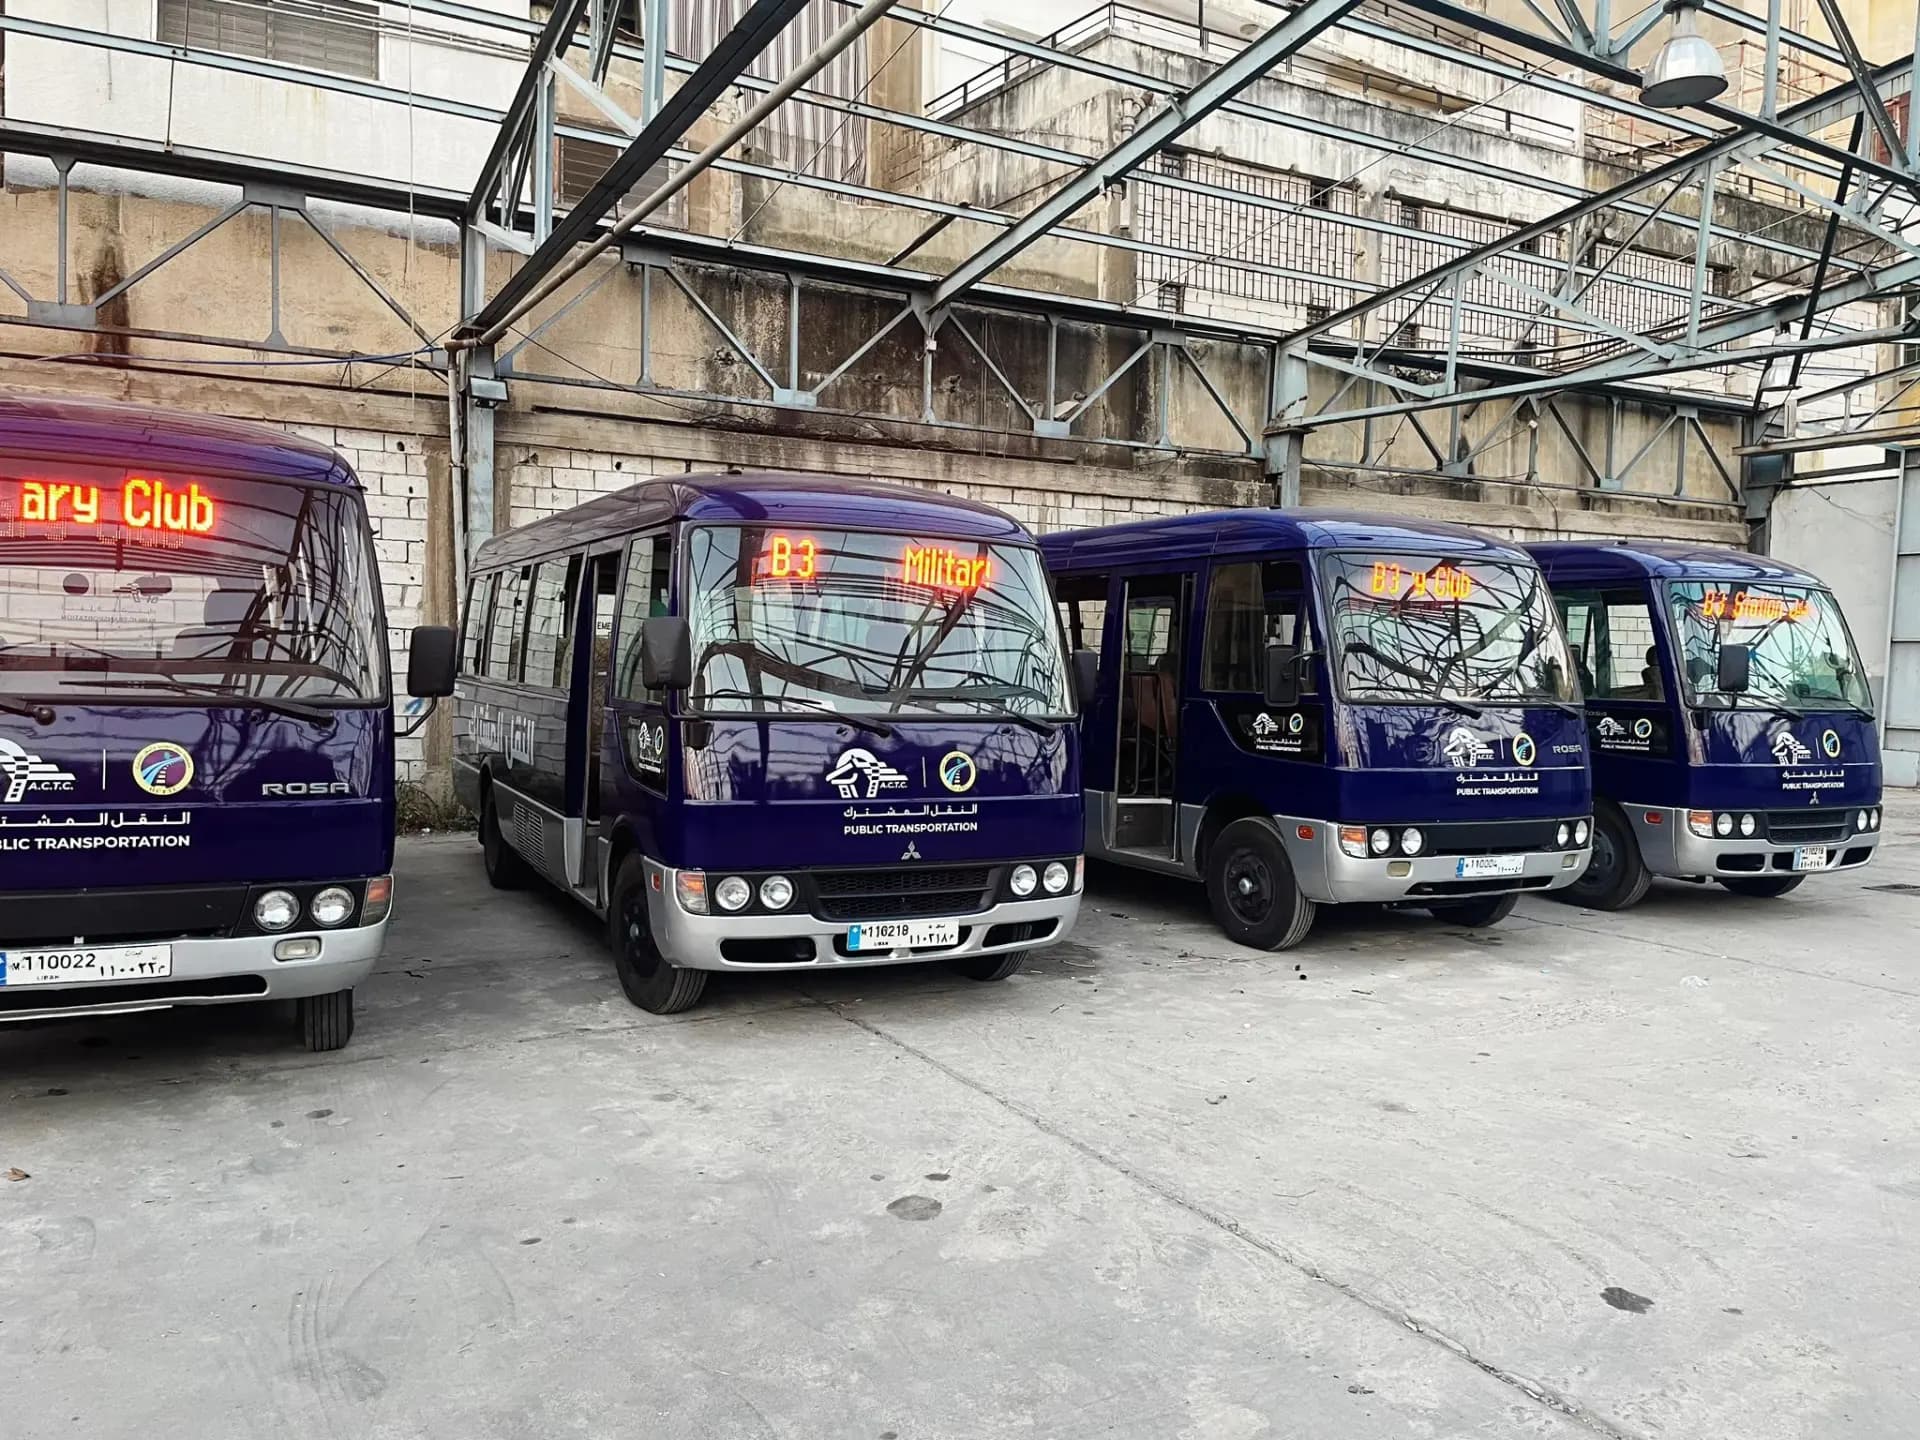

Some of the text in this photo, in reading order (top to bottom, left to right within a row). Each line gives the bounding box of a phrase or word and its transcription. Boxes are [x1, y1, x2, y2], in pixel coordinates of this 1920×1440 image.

[23, 479, 214, 531] ary Club
[772, 536, 814, 577] B3
[1373, 562, 1399, 594] B3
[1434, 566, 1471, 598] Club
[1552, 744, 1582, 753] ROSA
[28, 781, 74, 791] A.C.T.C.
[262, 783, 350, 796] ROSA
[1456, 786, 1539, 796] PUBLIC TRANSPORTATION
[930, 803, 978, 817] النقل
[0, 811, 191, 828] النقل المشت
[844, 822, 978, 835] PUBLIC TRANSPORTATION
[34, 835, 190, 850] TRANSPORTATION
